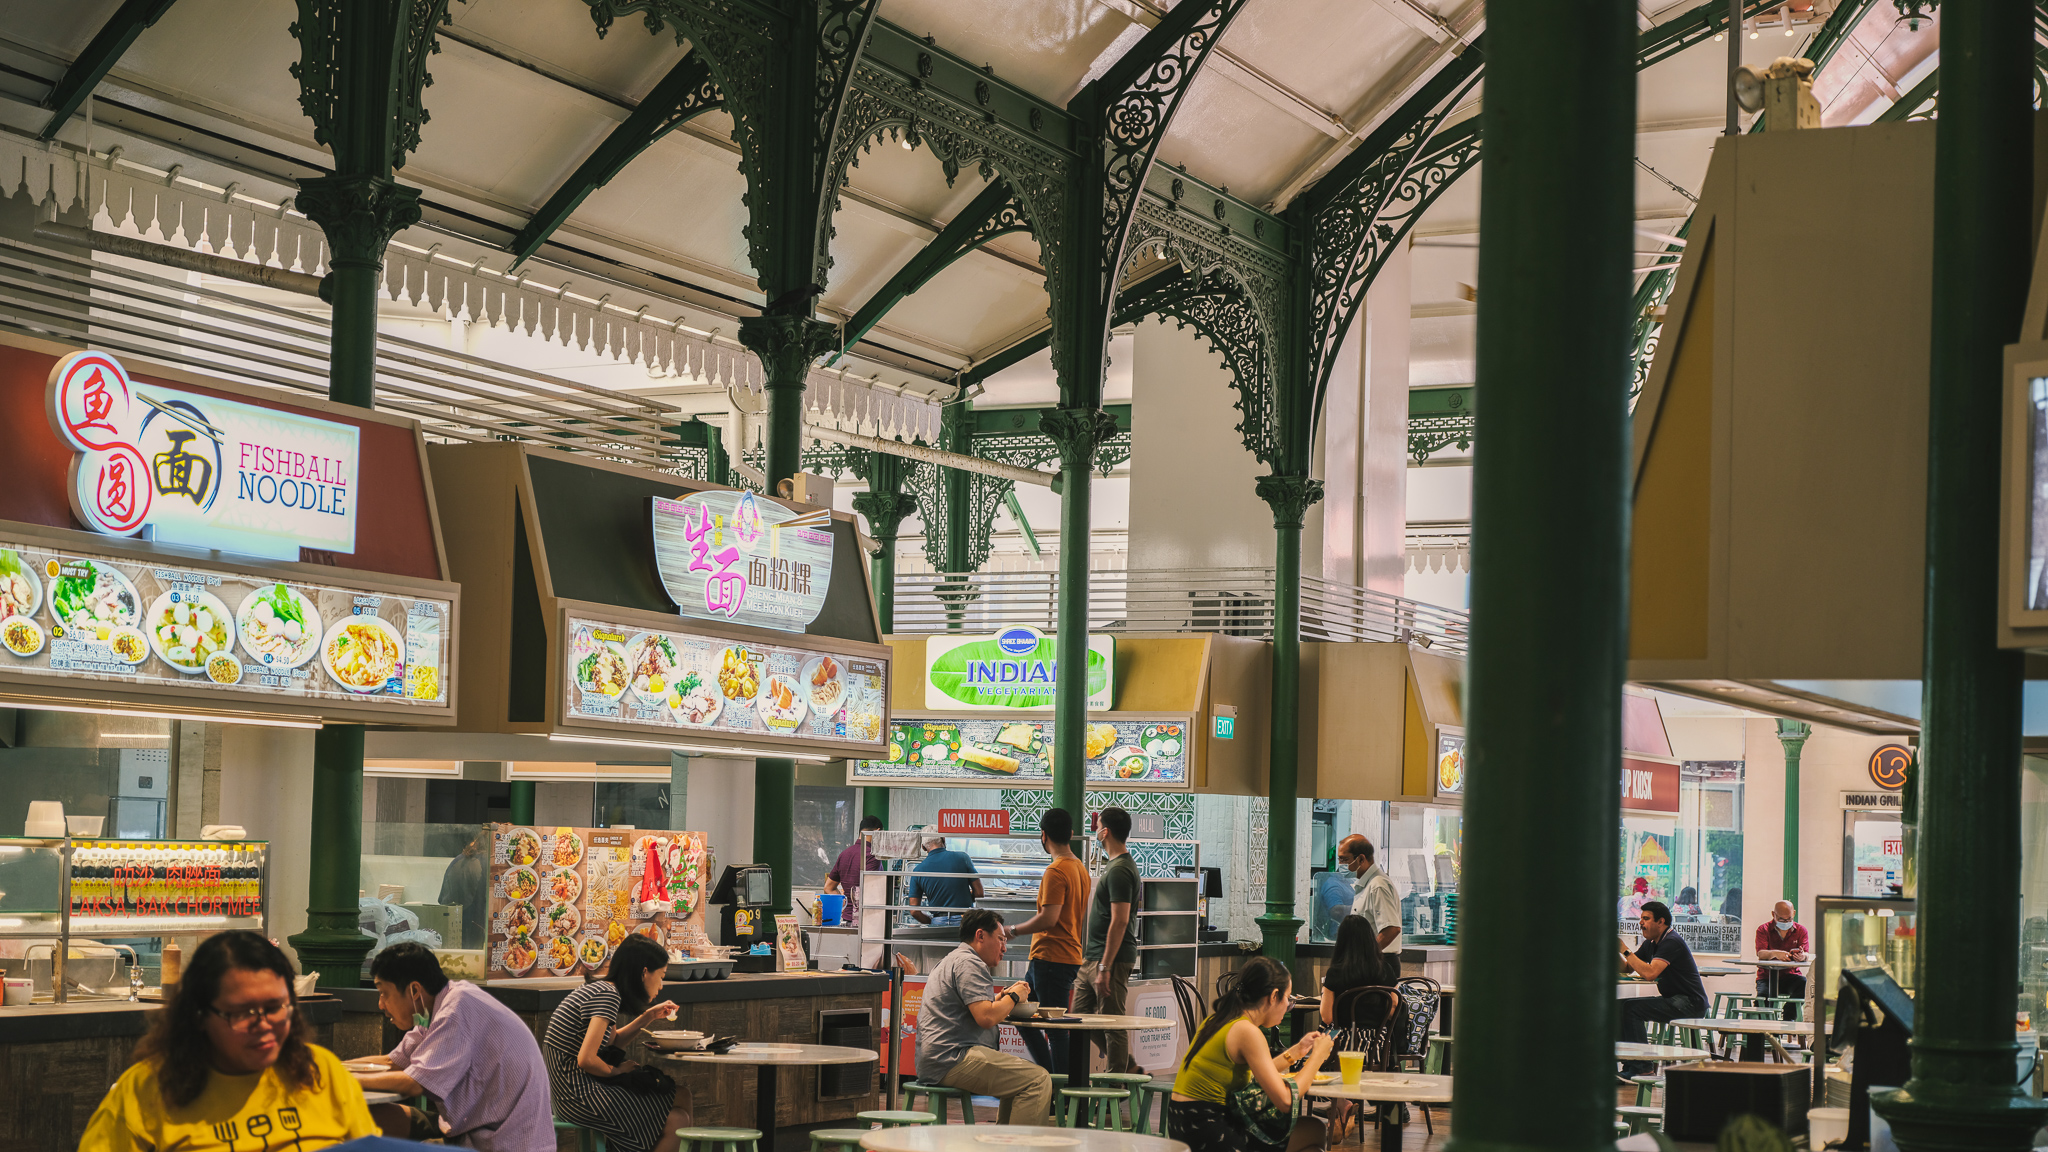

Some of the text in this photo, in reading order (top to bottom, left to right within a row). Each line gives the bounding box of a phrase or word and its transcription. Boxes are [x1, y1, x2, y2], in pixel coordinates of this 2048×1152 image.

[239, 442, 347, 486] FISHBALL
[238, 471, 346, 516] NOODLE
[61, 566, 89, 578] MUST TRY
[155, 570, 222, 586] FISHBALL NOODLE (Dry)
[748, 554, 812, 595] 面粉粿
[171, 593, 199, 604] 03 $4.50
[775, 593, 795, 606] MIAN
[797, 596, 803, 606] &
[746, 600, 803, 618] MEE HOON KUEH
[52, 626, 63, 637] 02
[595, 629, 623, 643] Signature
[51, 640, 86, 650] SIGNATURE
[264, 654, 273, 663] 04
[244, 664, 309, 679] FISHBALL NOODLE (Soup)
[770, 715, 796, 728] Signature
[926, 723, 953, 732] Signature
[1217, 719, 1230, 735] EXIT
[1632, 769, 1653, 800] KIOSK
[1845, 794, 1877, 806] INDIAN
[943, 812, 1004, 829] NON HALAL
[1138, 818, 1155, 833] HALAL
[113, 864, 155, 889] 叻沙
[69, 895, 261, 919] LAKSA, BAK CHOR MEE
[1619, 922, 1641, 931] BIRYA
[1153, 1006, 1167, 1019] GOOD
[998, 1027, 1021, 1036] RETU
[999, 1037, 1009, 1045] AY
[1140, 1035, 1151, 1043] YOUR
